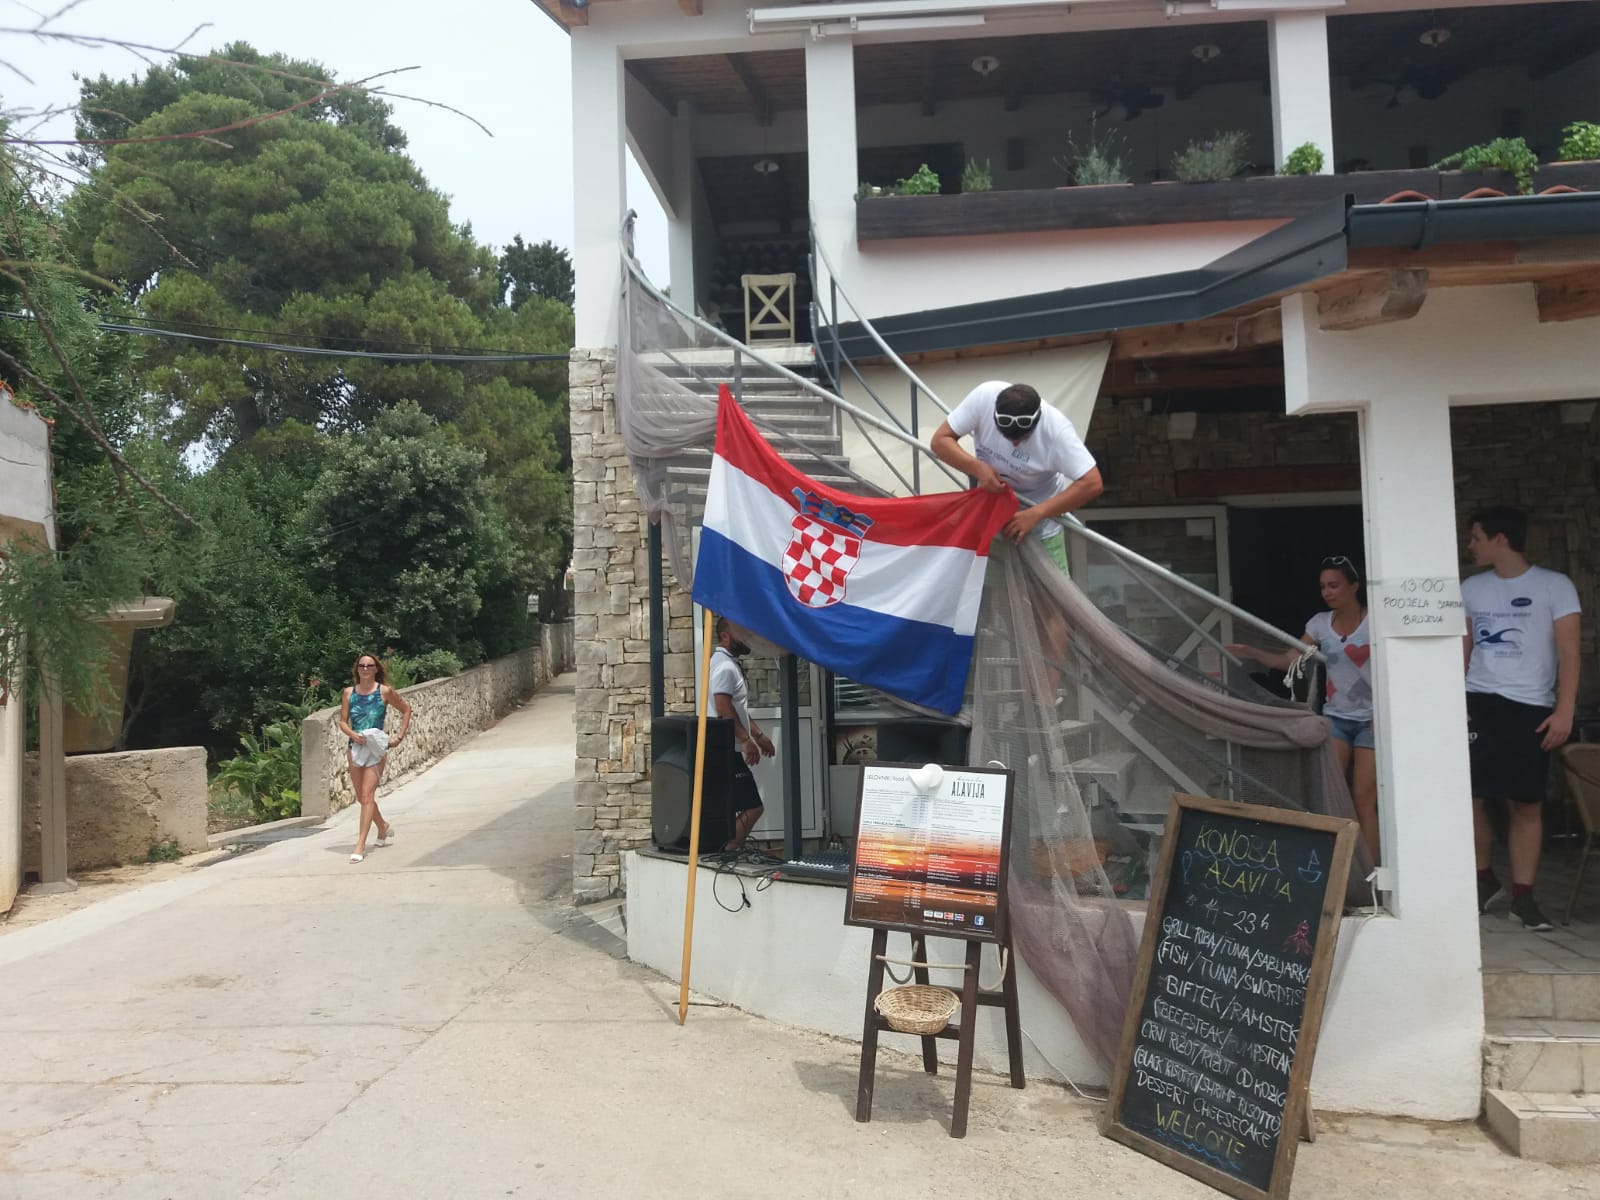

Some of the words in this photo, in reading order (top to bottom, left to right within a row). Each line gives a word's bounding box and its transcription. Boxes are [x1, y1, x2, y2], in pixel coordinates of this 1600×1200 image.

[951, 781, 985, 799] ALAVIJA
[1195, 825, 1280, 867] KONOBA
[1162, 916, 1192, 940] GRILL
[1140, 1021, 1167, 1043] CRNI
[1236, 1067, 1254, 1088] OD
[1136, 1070, 1190, 1104] DESSERT
[1192, 1098, 1272, 1148] CHEESECAKE
